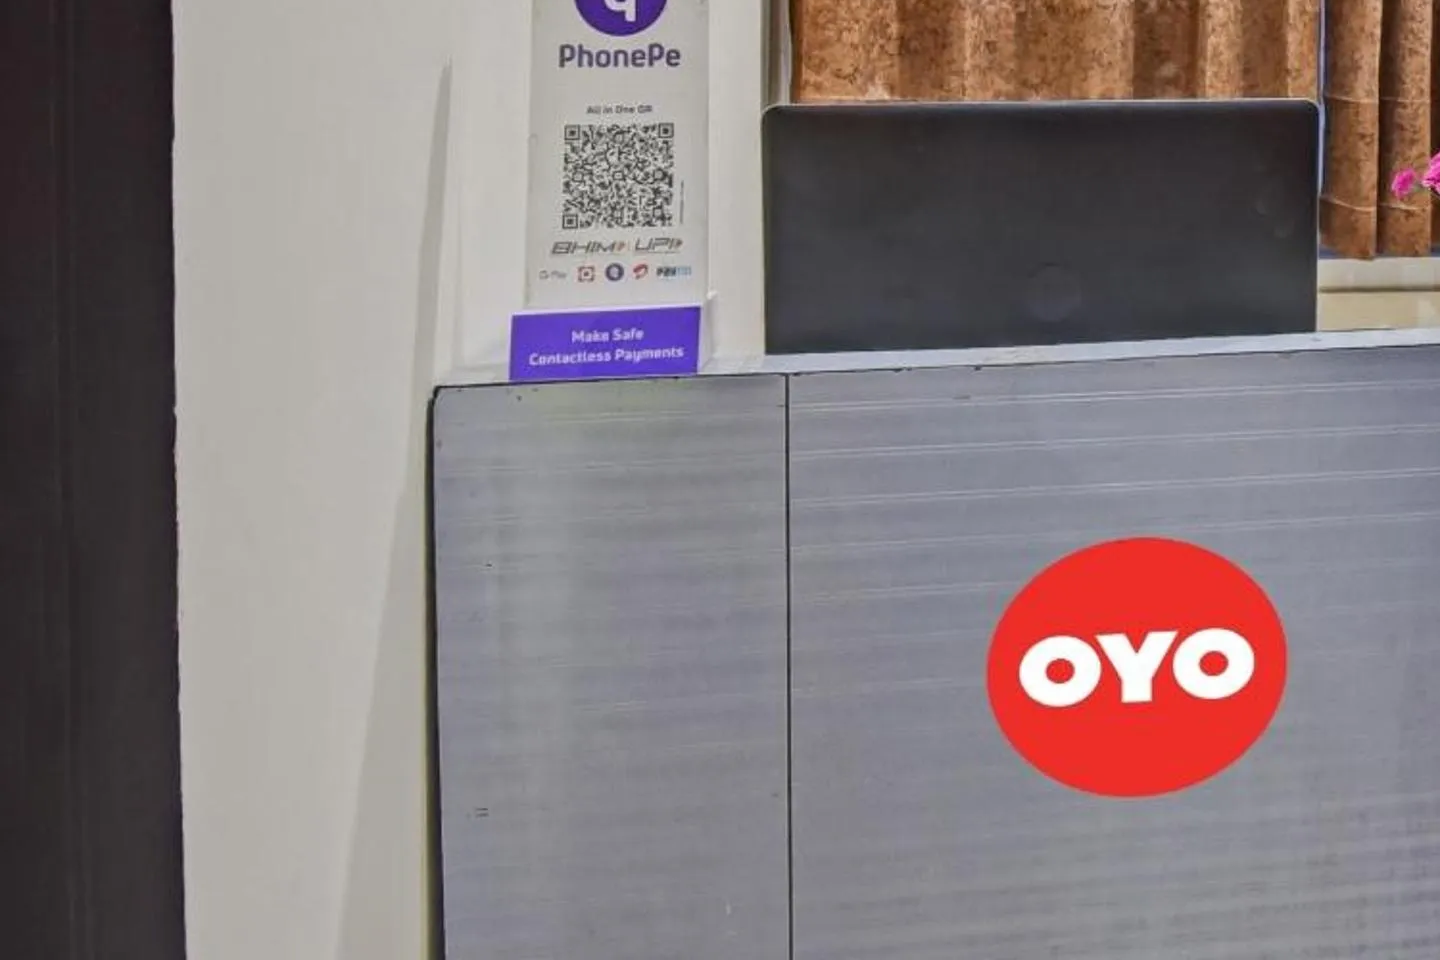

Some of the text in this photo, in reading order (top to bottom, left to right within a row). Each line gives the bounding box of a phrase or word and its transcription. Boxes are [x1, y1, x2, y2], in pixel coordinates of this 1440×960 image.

[558, 43, 681, 68] PhonePe
[571, 328, 645, 343] Make Safe
[528, 346, 684, 366] Contactless Payments
[1019, 628, 1255, 708] OYO
